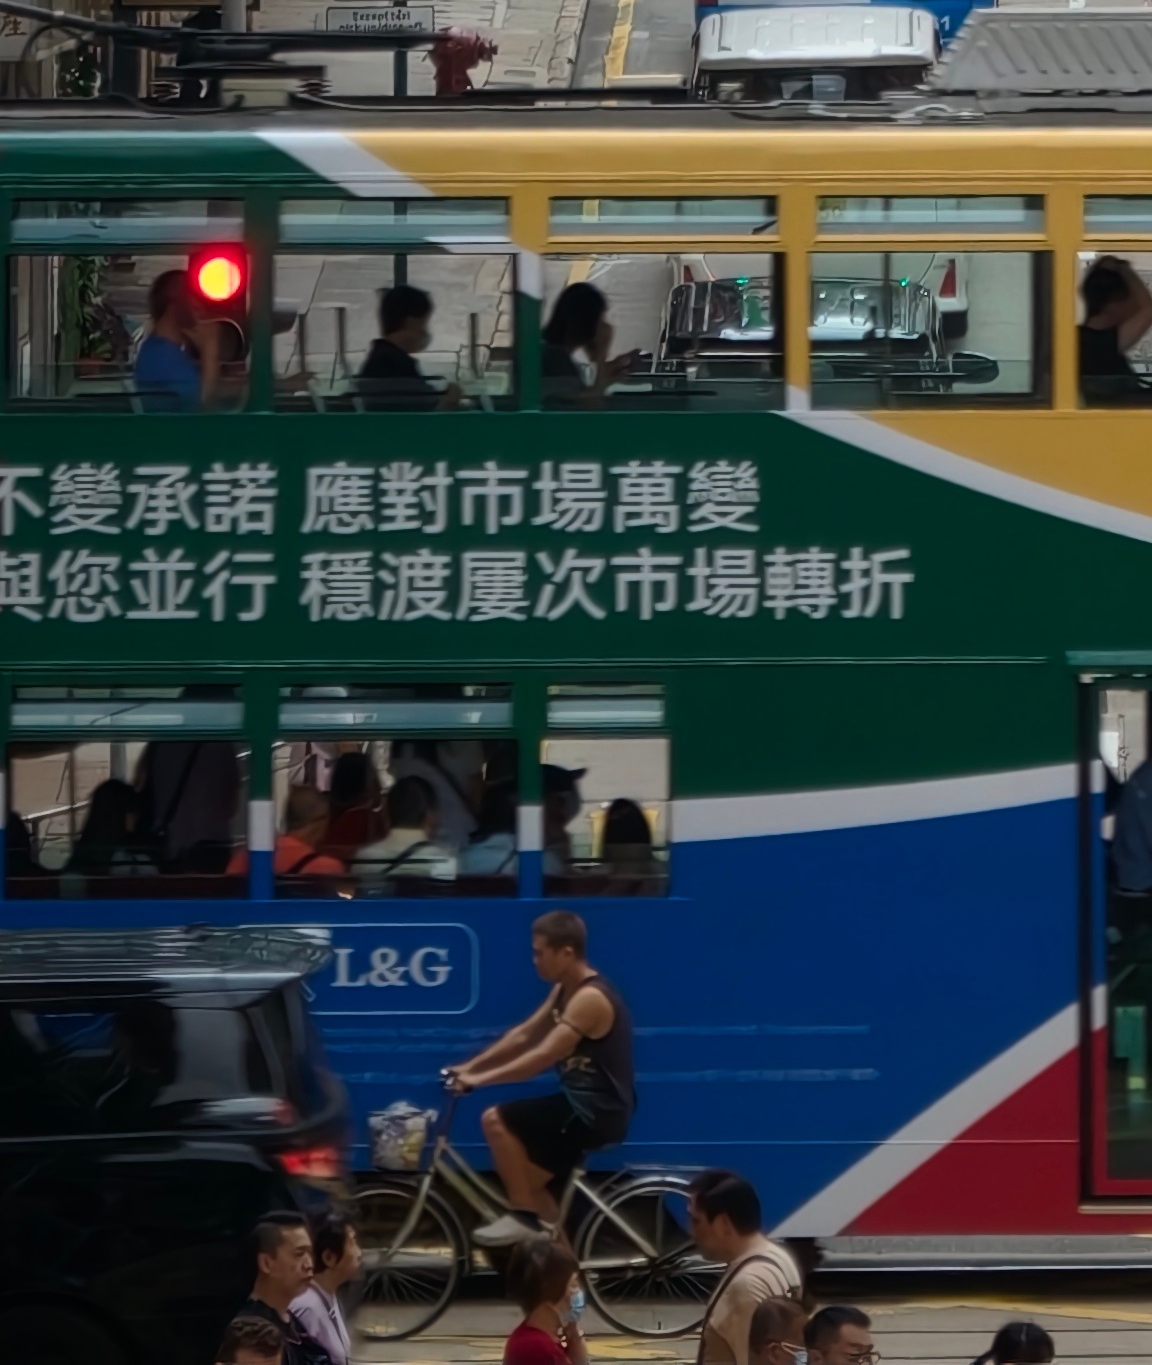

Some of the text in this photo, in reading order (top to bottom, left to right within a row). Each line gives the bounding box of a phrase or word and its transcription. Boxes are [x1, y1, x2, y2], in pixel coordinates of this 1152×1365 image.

[0, 461, 760, 536] 不變承諾 應對市場萬變
[0, 547, 915, 623] 與您並行 穩渡屢次市場轉折
[331, 947, 453, 988] L&G
